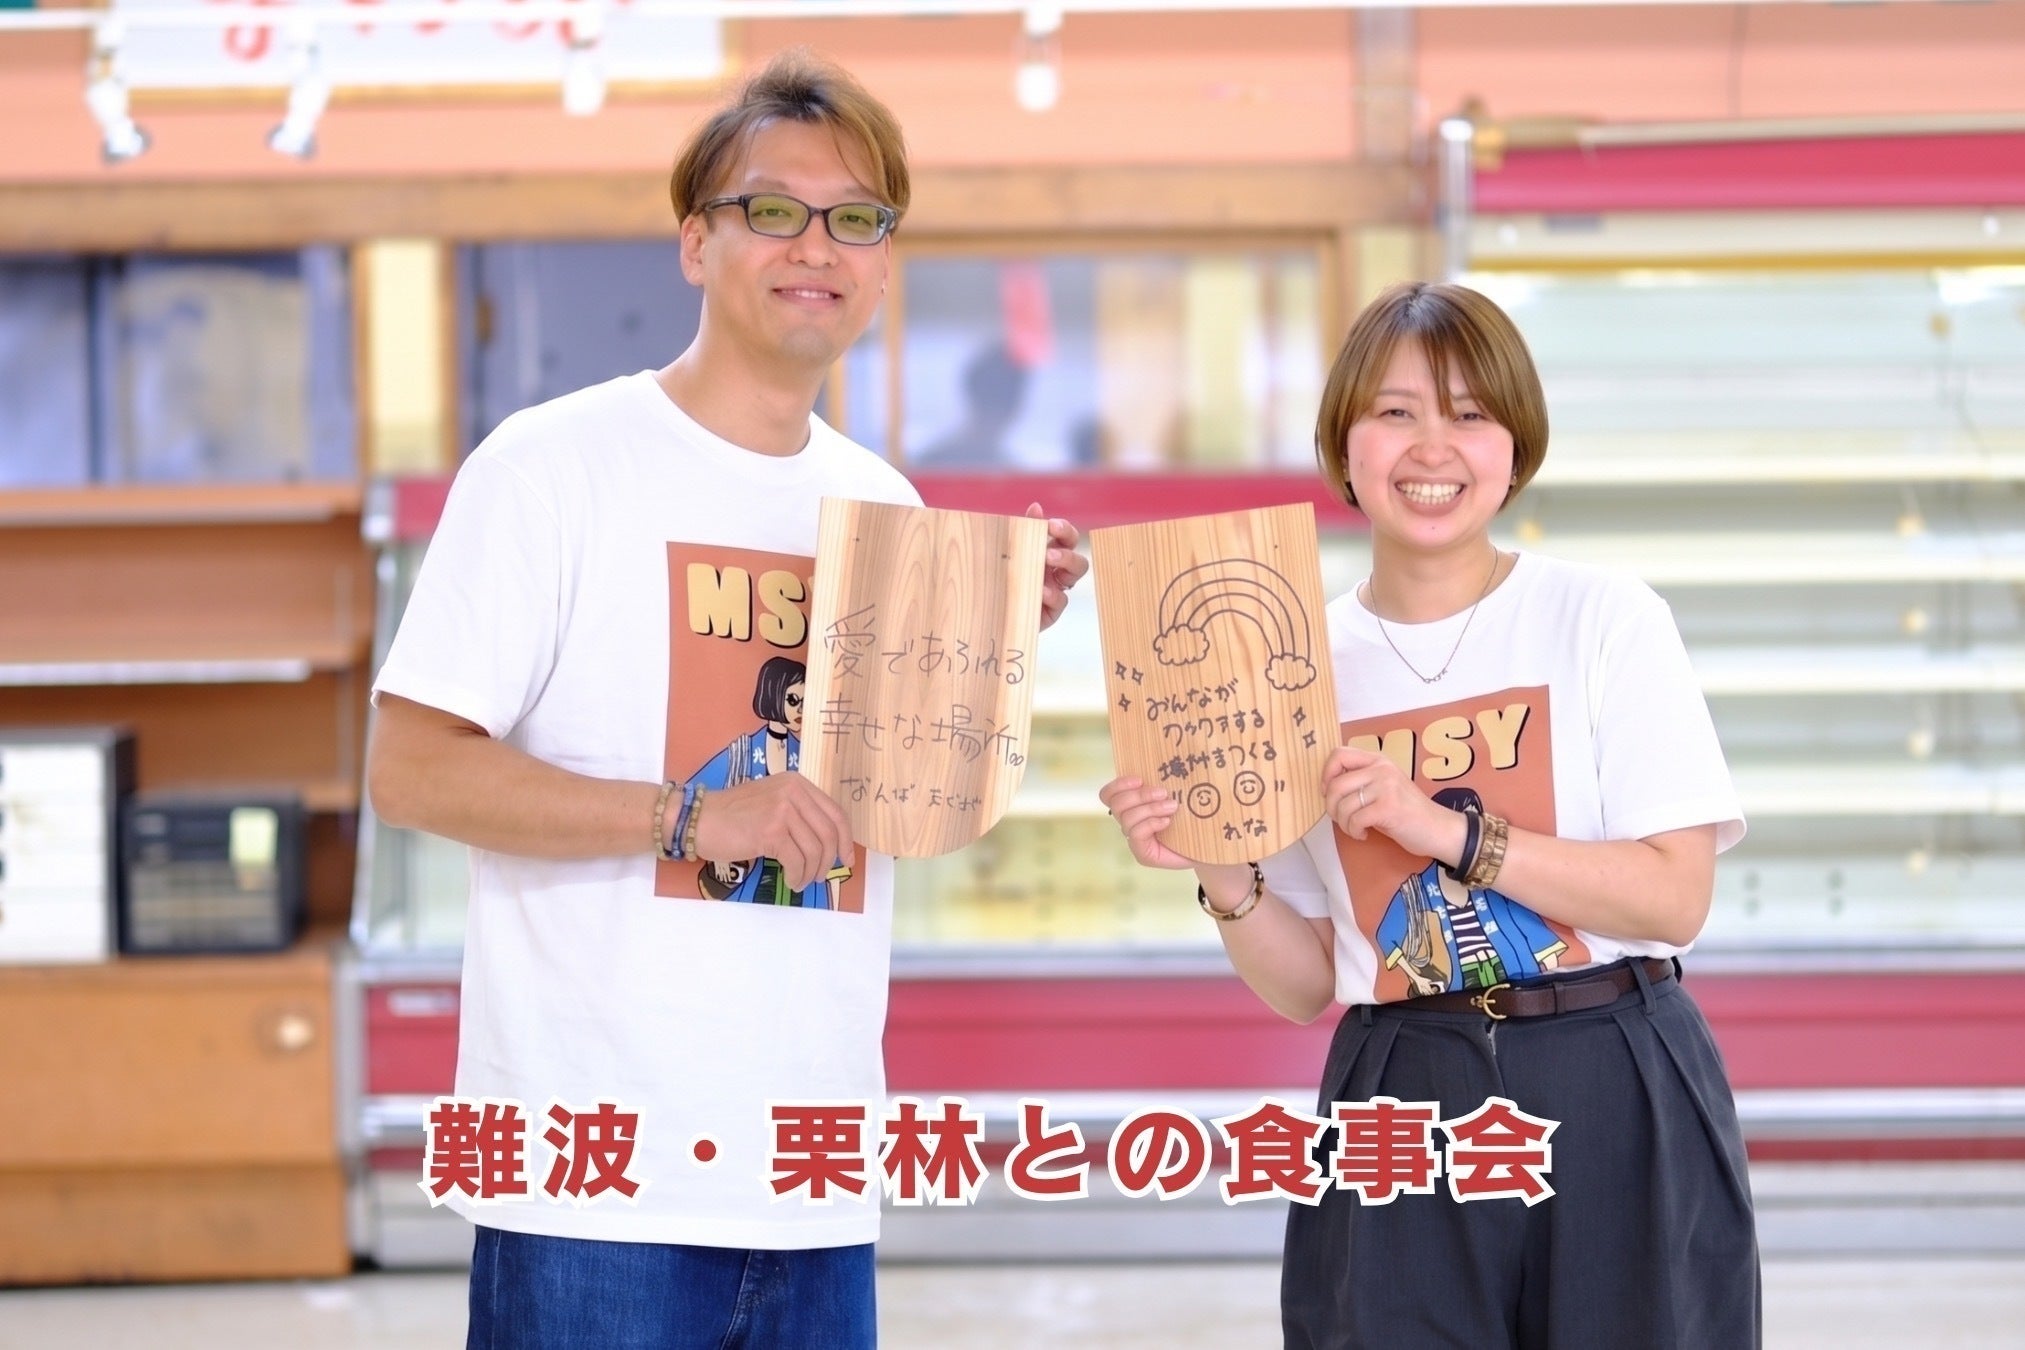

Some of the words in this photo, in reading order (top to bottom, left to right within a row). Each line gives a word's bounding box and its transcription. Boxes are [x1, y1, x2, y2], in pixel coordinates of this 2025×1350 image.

[687, 562, 814, 648] MS
[824, 603, 1024, 684] 愛であふれる
